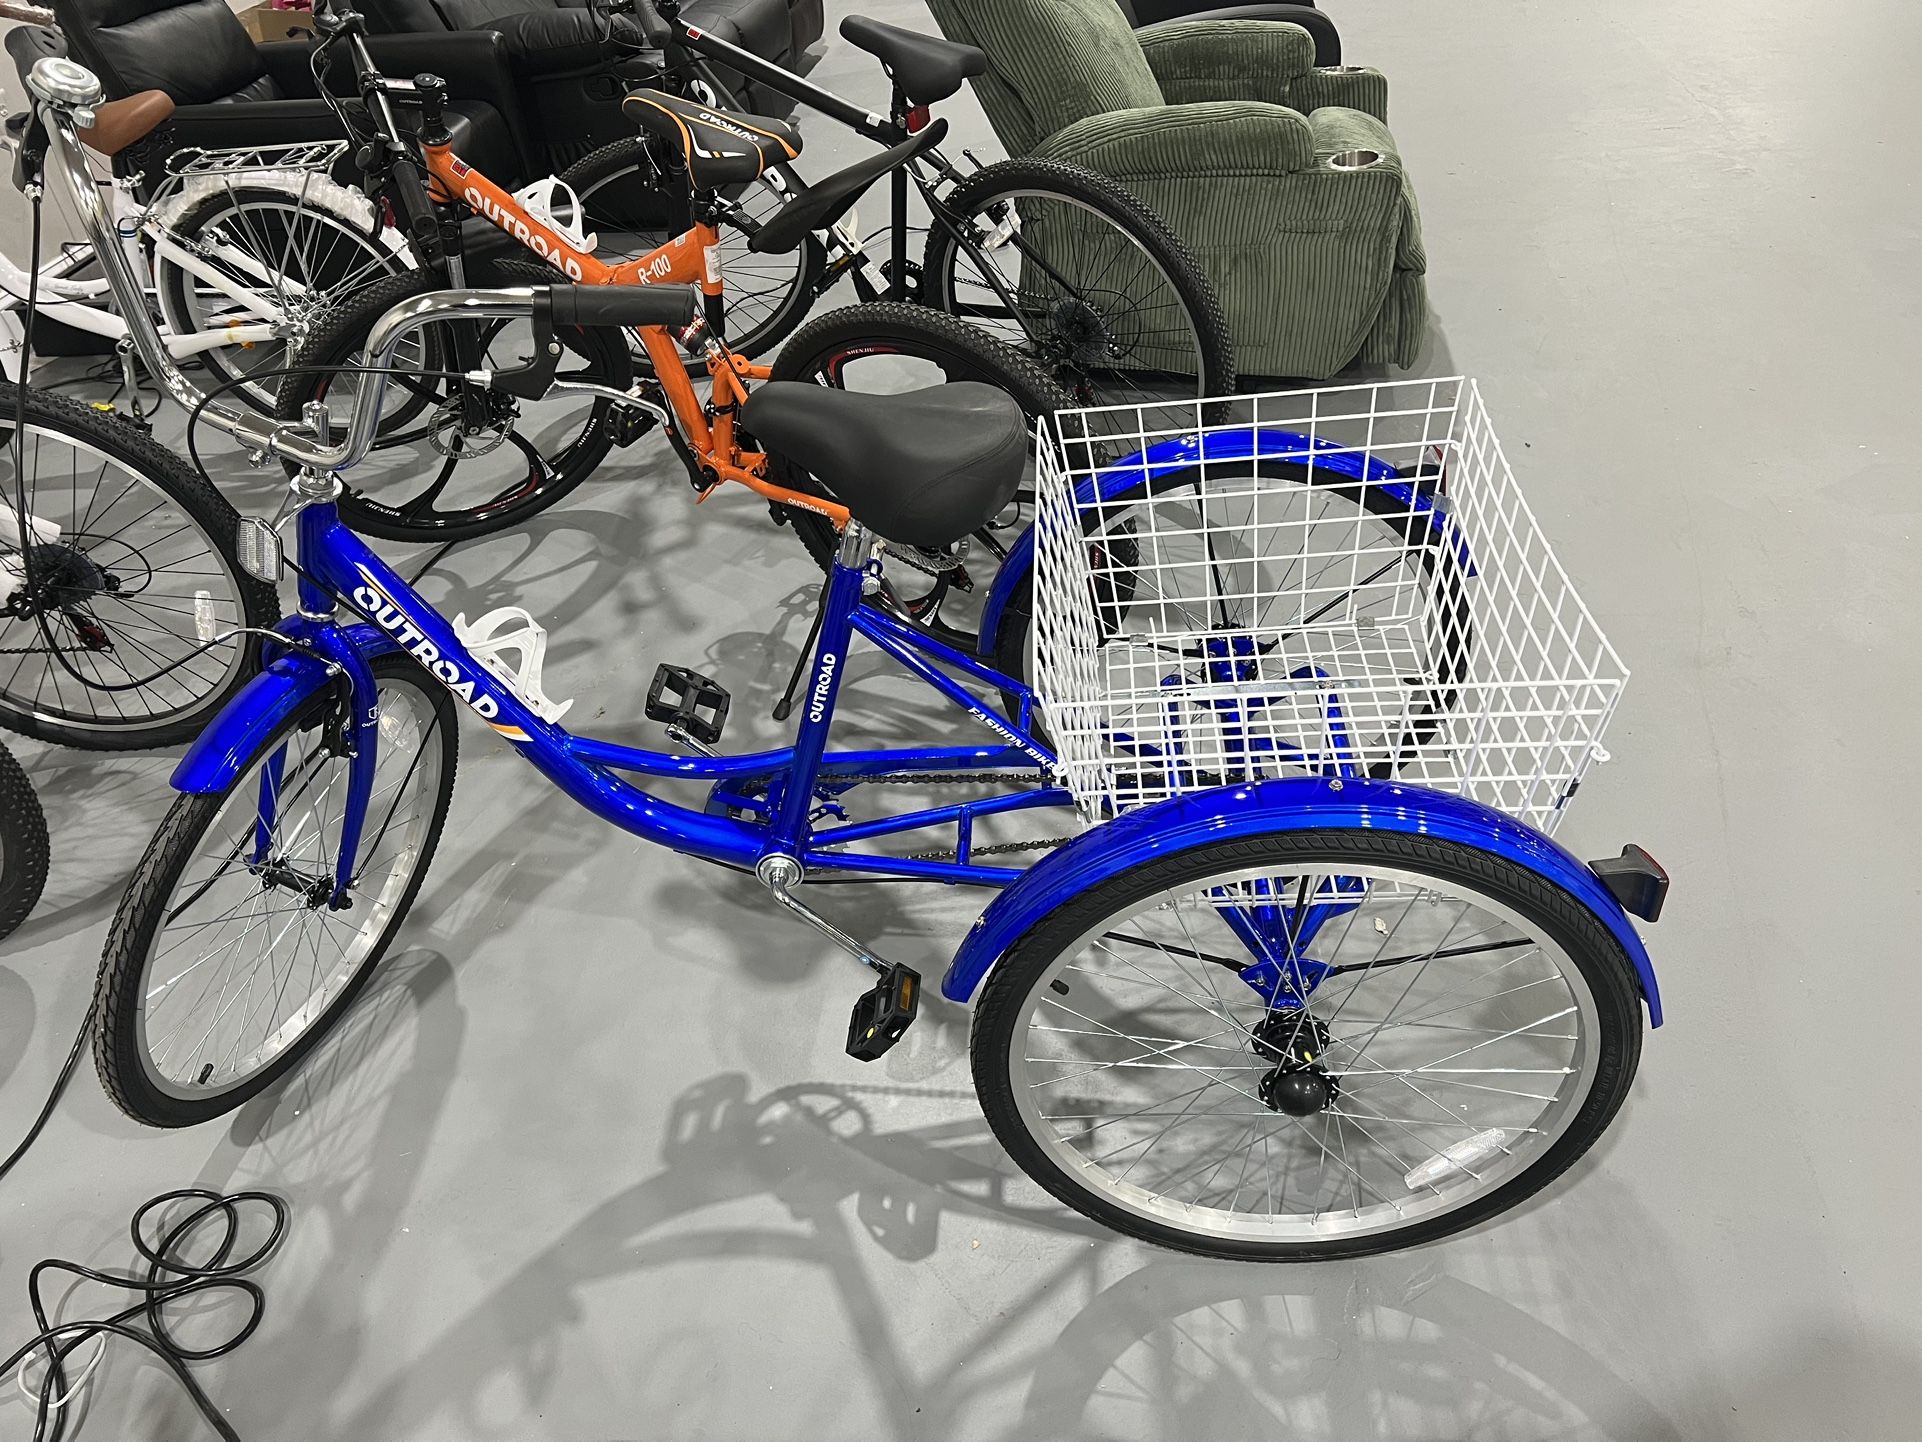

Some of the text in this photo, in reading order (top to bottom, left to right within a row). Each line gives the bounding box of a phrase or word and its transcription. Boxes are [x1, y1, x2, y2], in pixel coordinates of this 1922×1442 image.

[699, 112, 759, 141] OUTROAD
[464, 186, 583, 282] OUTROAD
[637, 253, 672, 285] R-100
[365, 502, 402, 517] SHENJIU
[353, 586, 499, 719] OUTROAD
[809, 653, 837, 723] OUTROAD
[967, 706, 1027, 748] FASHION
